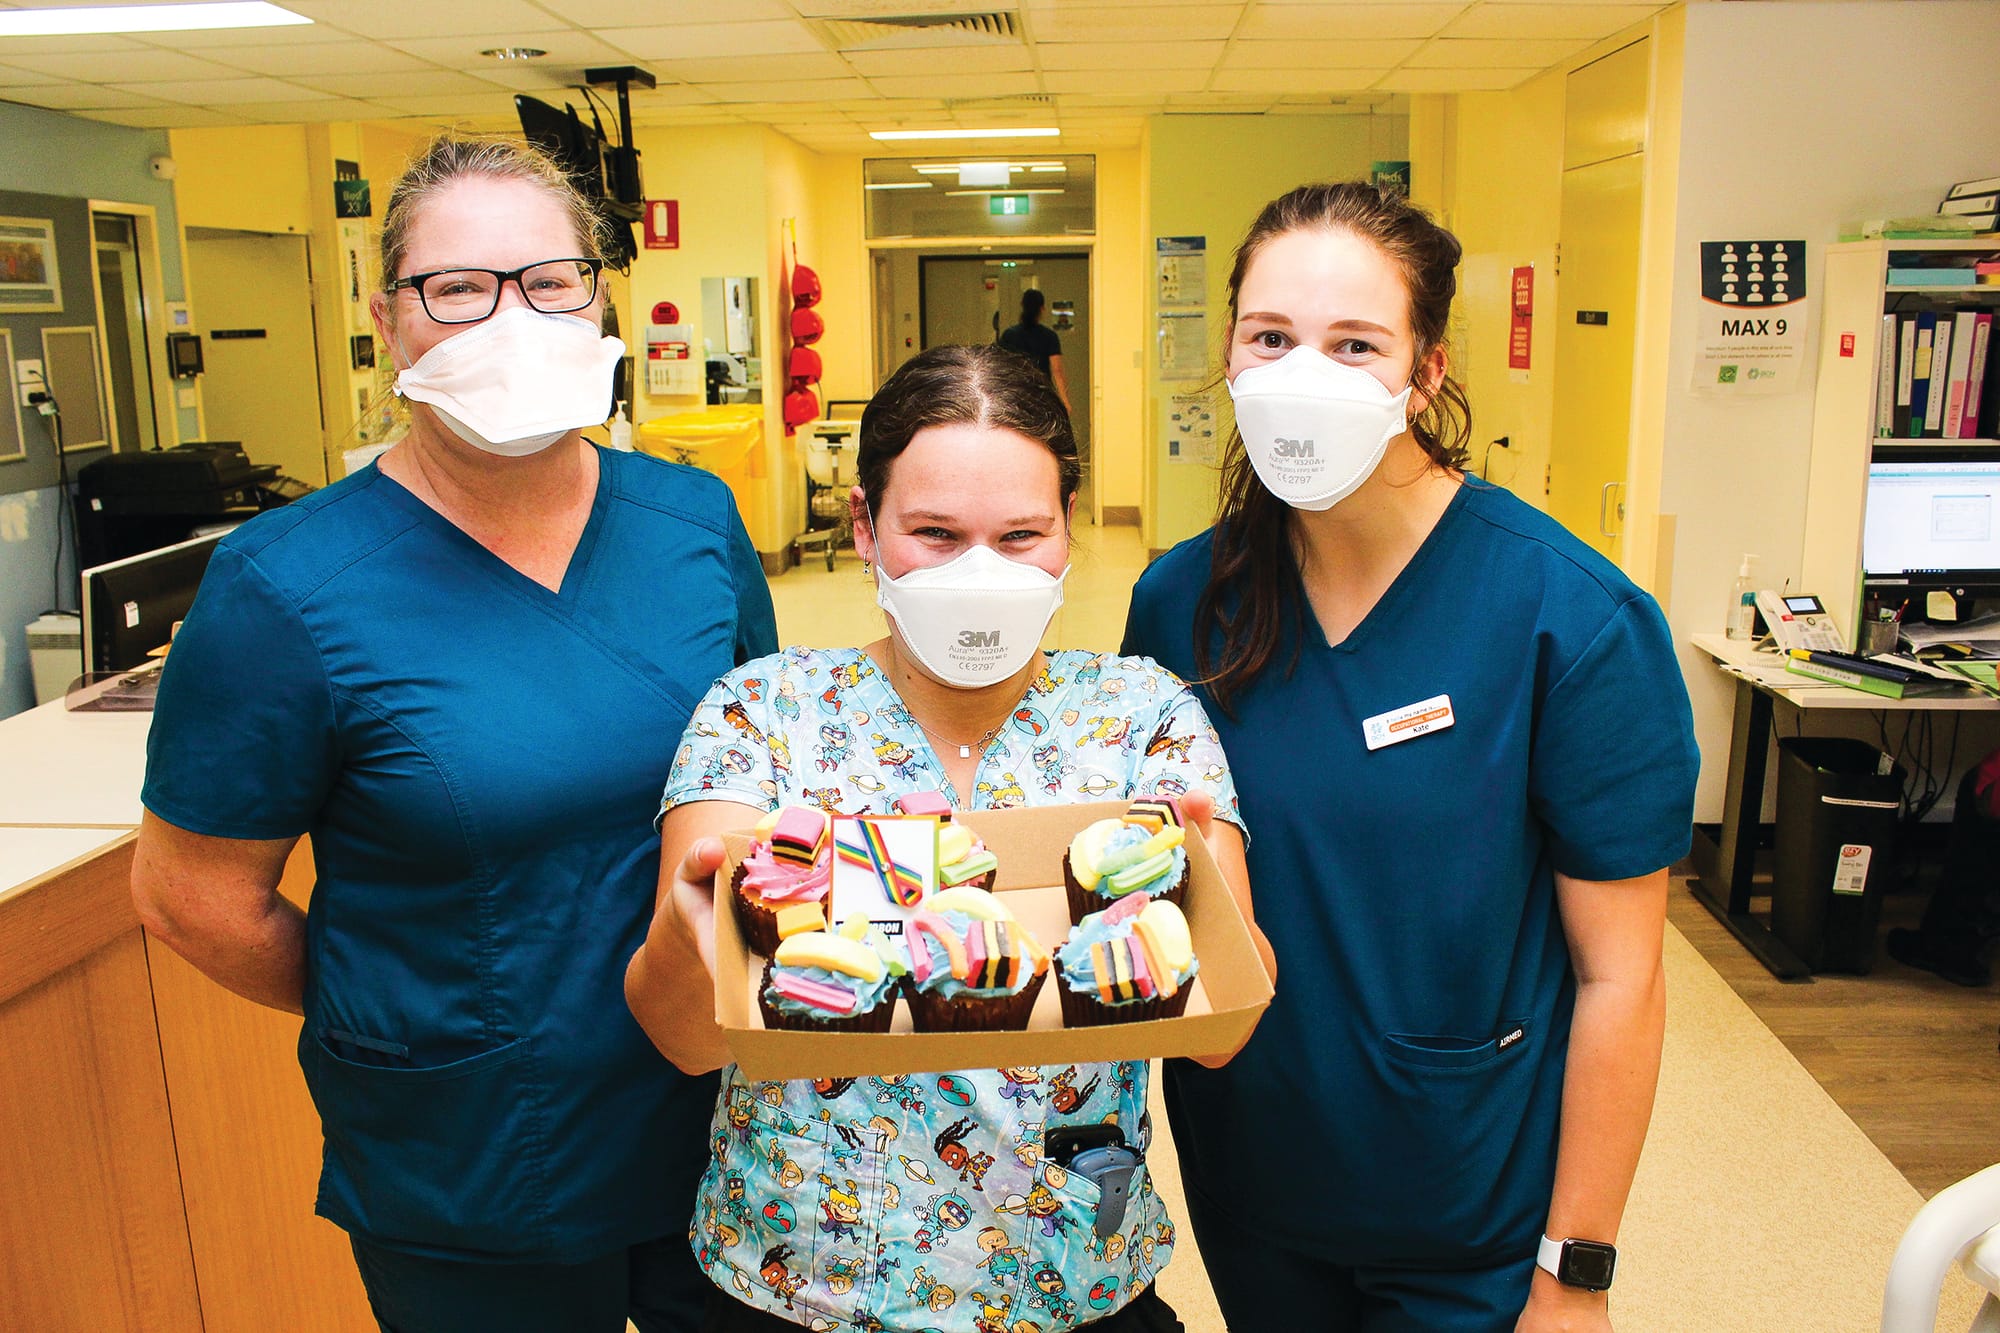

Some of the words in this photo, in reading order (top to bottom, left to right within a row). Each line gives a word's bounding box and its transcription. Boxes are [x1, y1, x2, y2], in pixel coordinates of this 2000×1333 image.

[1517, 277, 1529, 289] CALL
[1721, 319, 1769, 336] MAX
[1776, 319, 1787, 336] 9
[1273, 438, 1314, 457] 3M
[957, 630, 1000, 648] 3M
[1390, 717, 1425, 732] OCCUPATIONAL
[1425, 708, 1447, 721] THERAPY
[1412, 723, 1430, 734] Kate
